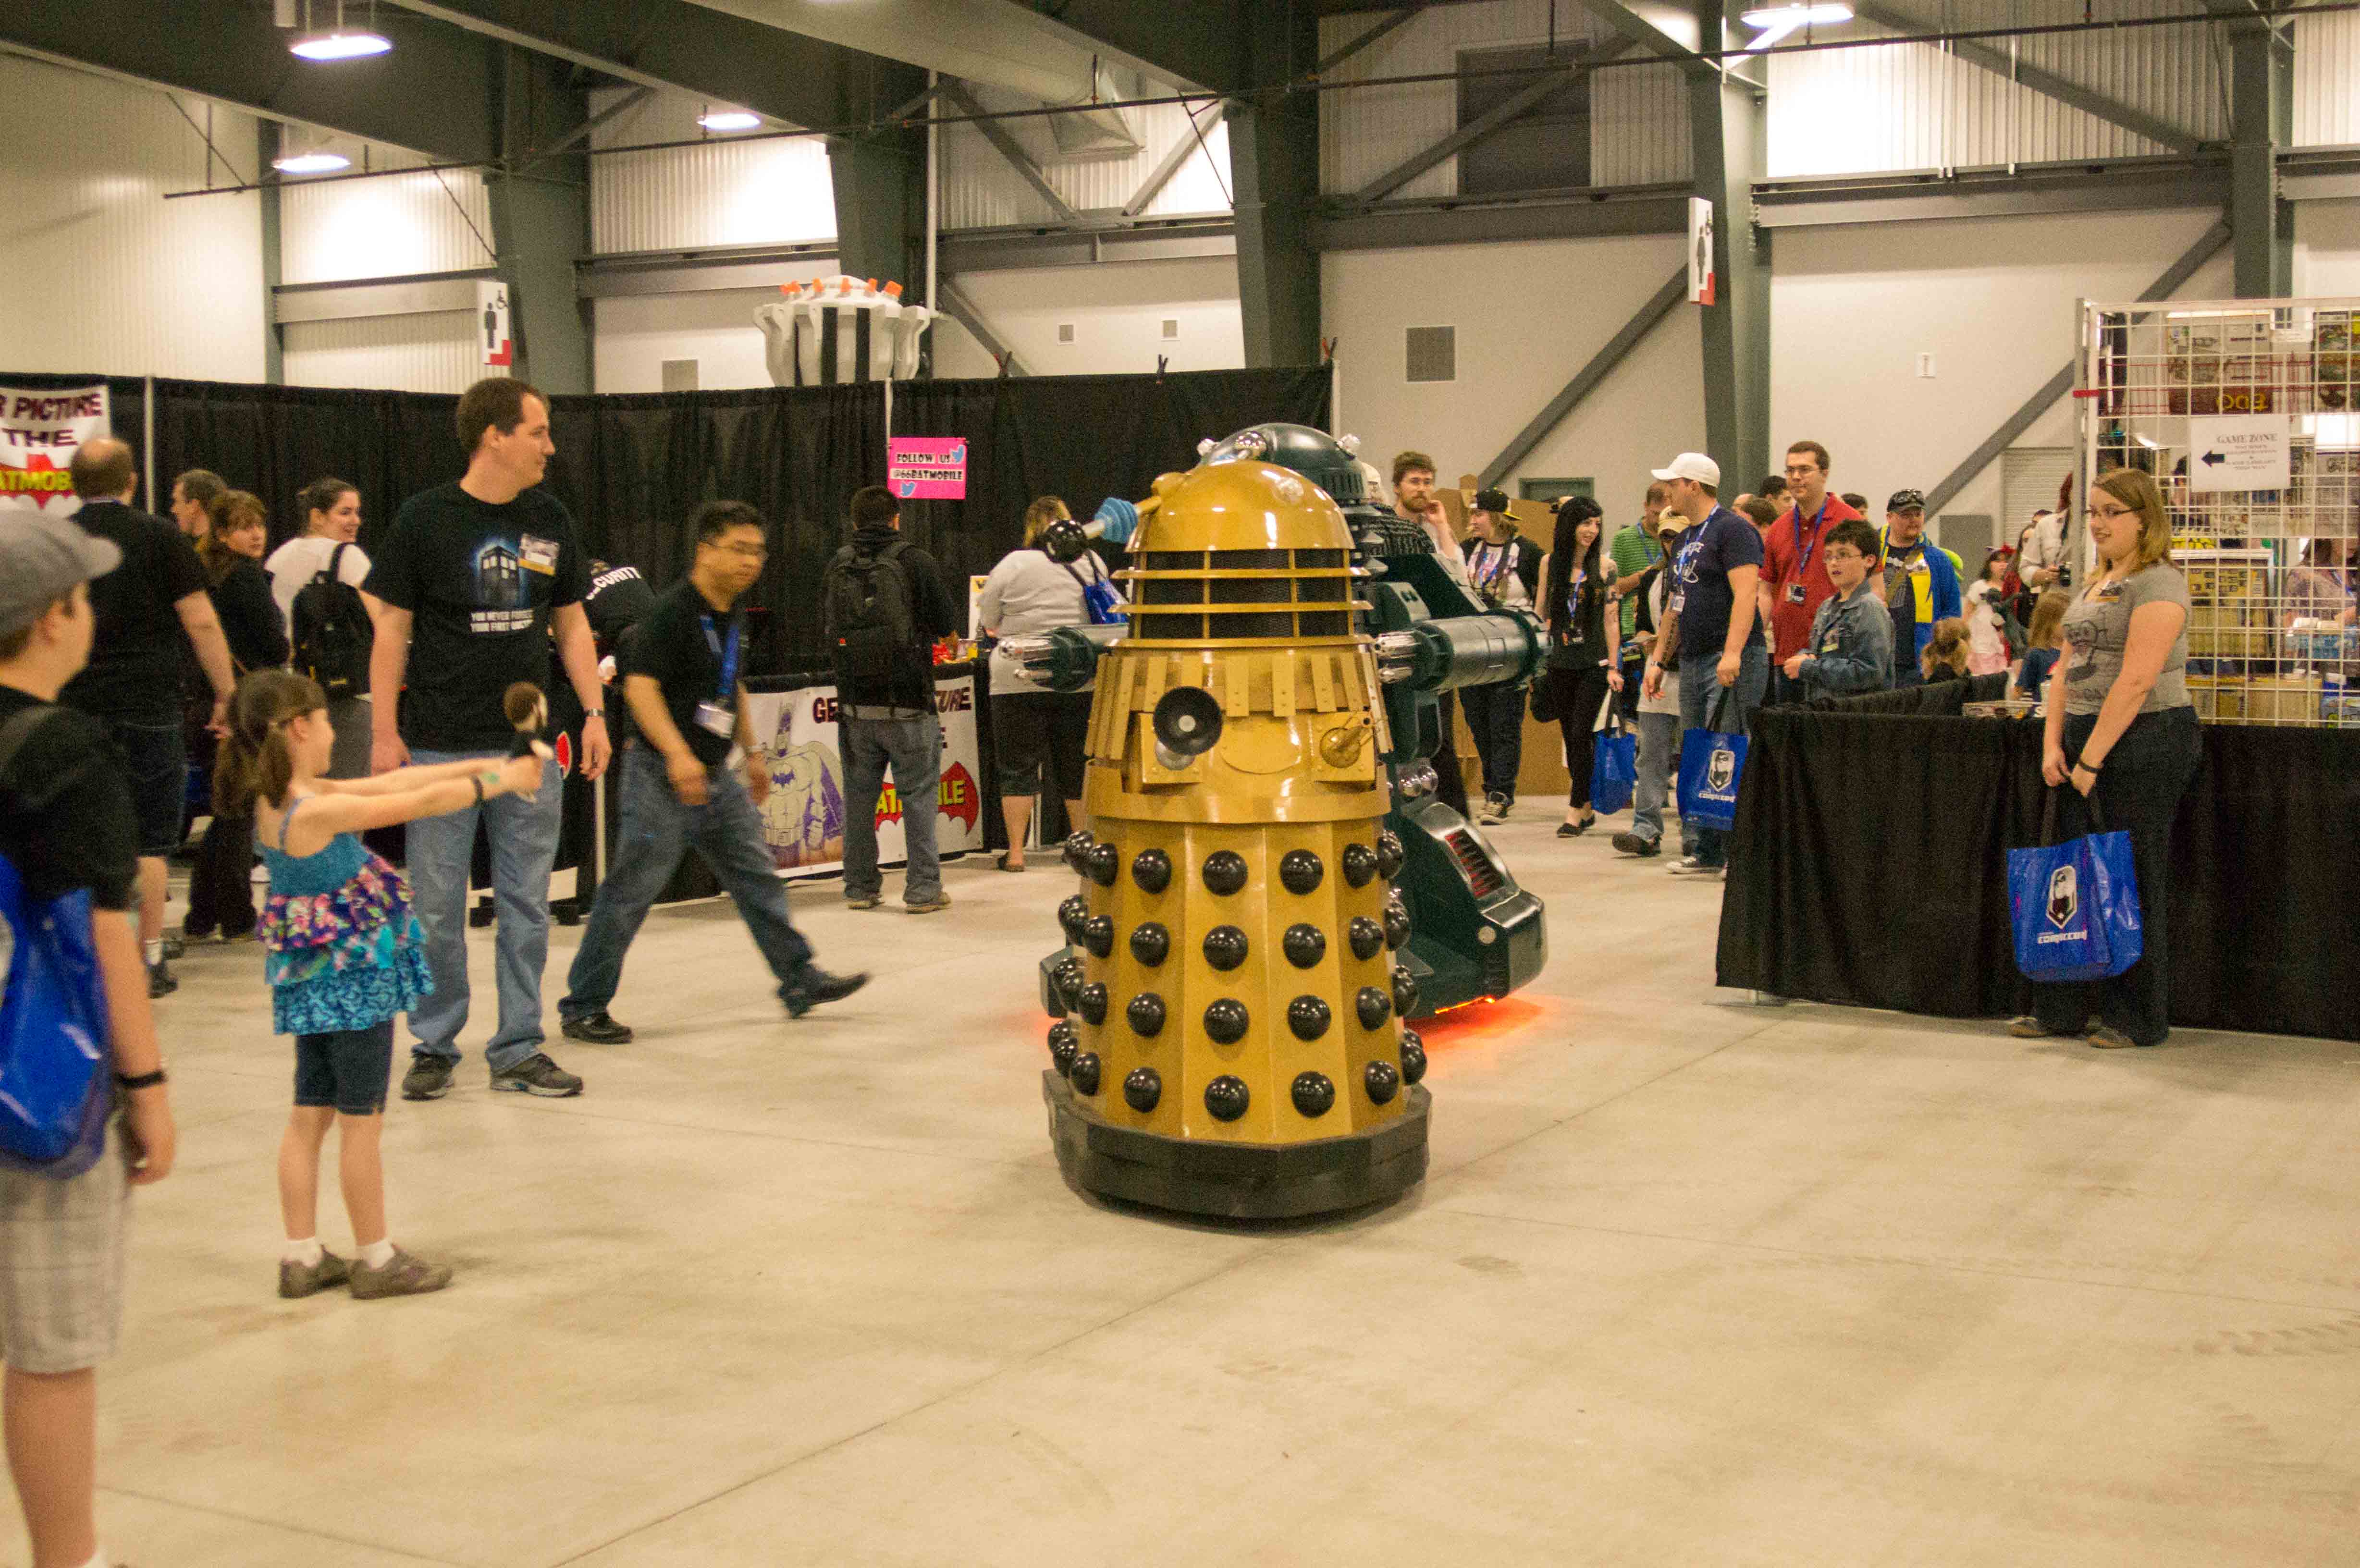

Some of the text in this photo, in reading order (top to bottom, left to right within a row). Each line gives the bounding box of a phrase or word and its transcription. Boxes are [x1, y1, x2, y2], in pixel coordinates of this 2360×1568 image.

[1, 428, 78, 448] THE
[2216, 433, 2278, 444] GAME ZONE
[897, 453, 933, 463] FOLLOW
